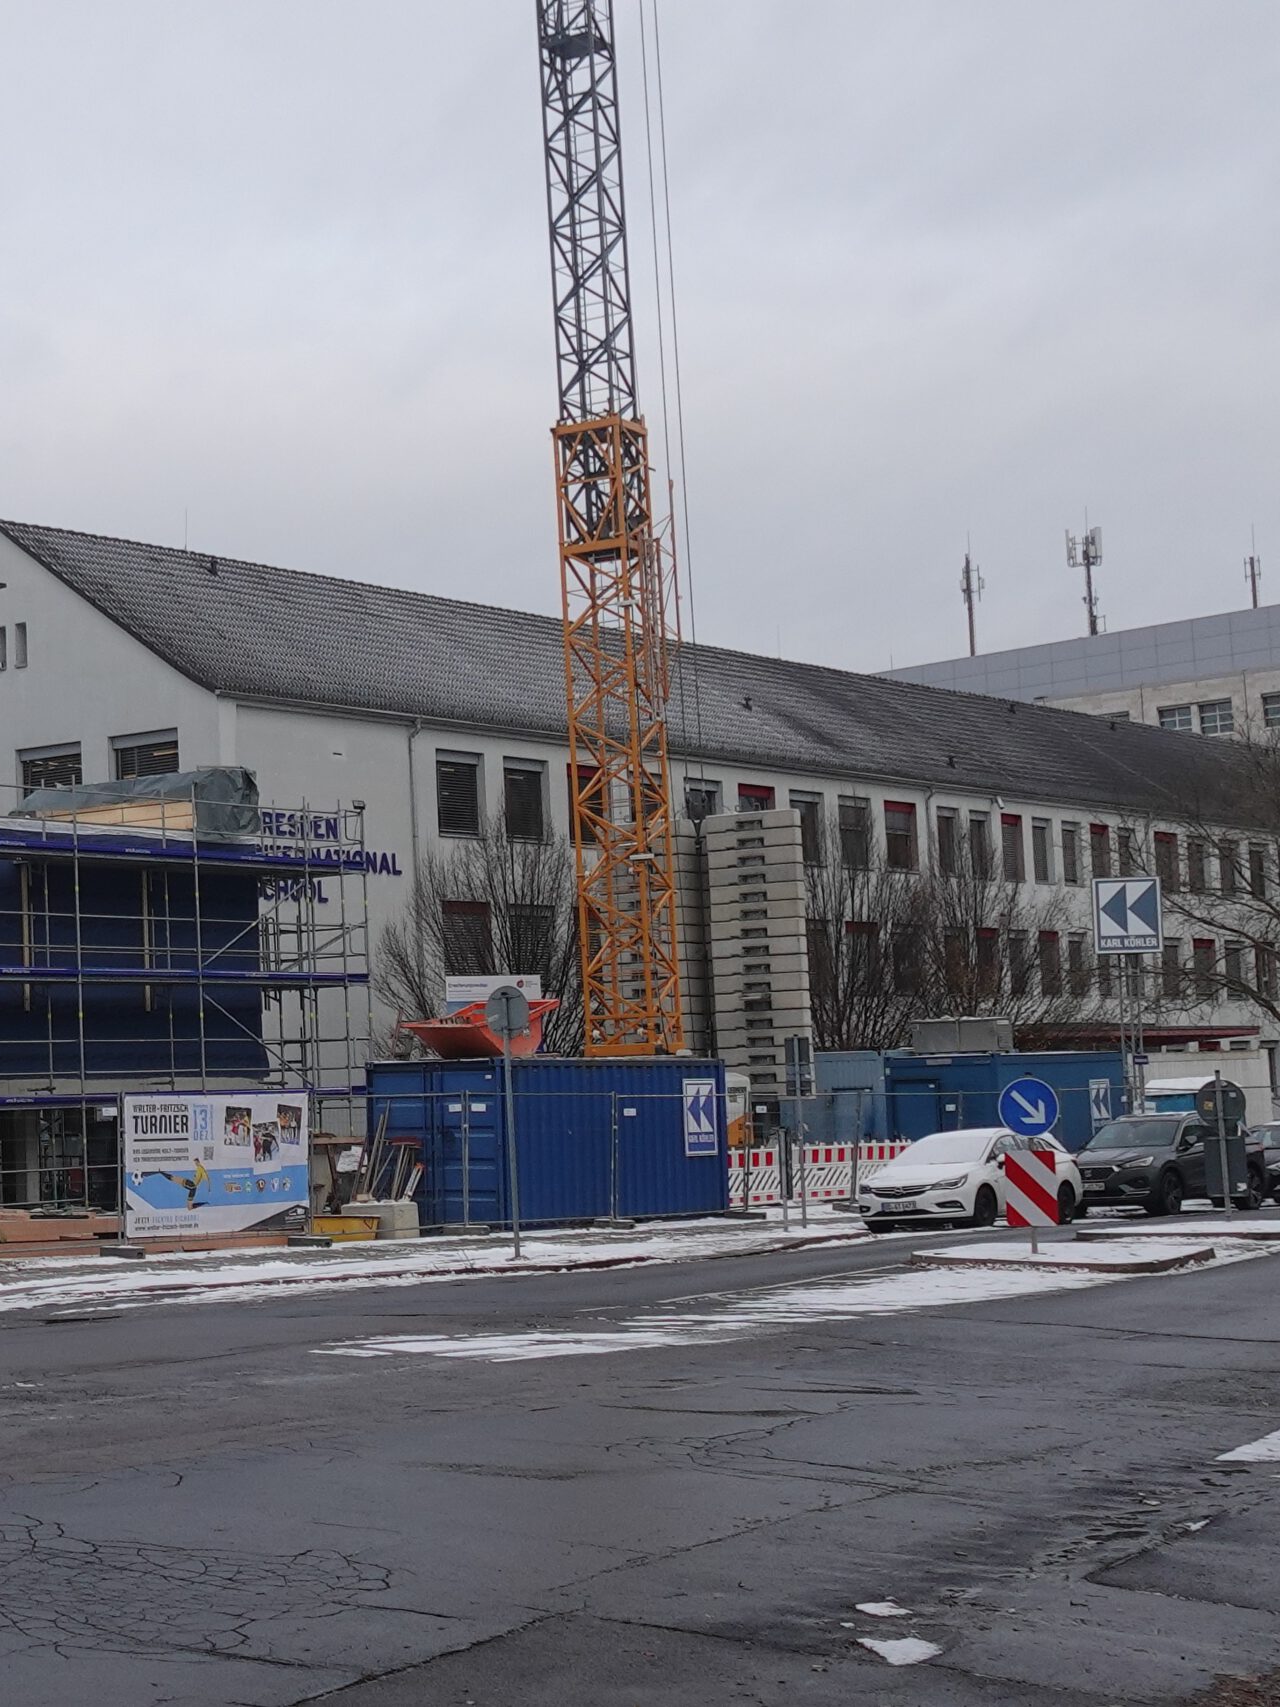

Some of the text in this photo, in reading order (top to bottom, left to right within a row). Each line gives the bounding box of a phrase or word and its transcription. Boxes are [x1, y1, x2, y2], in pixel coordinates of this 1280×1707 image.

[261, 811, 338, 840] RESDEN
[1101, 936, 1158, 948] KARL KÖHLER
[132, 1114, 189, 1135] TURNIER
[193, 1109, 208, 1130] 13
